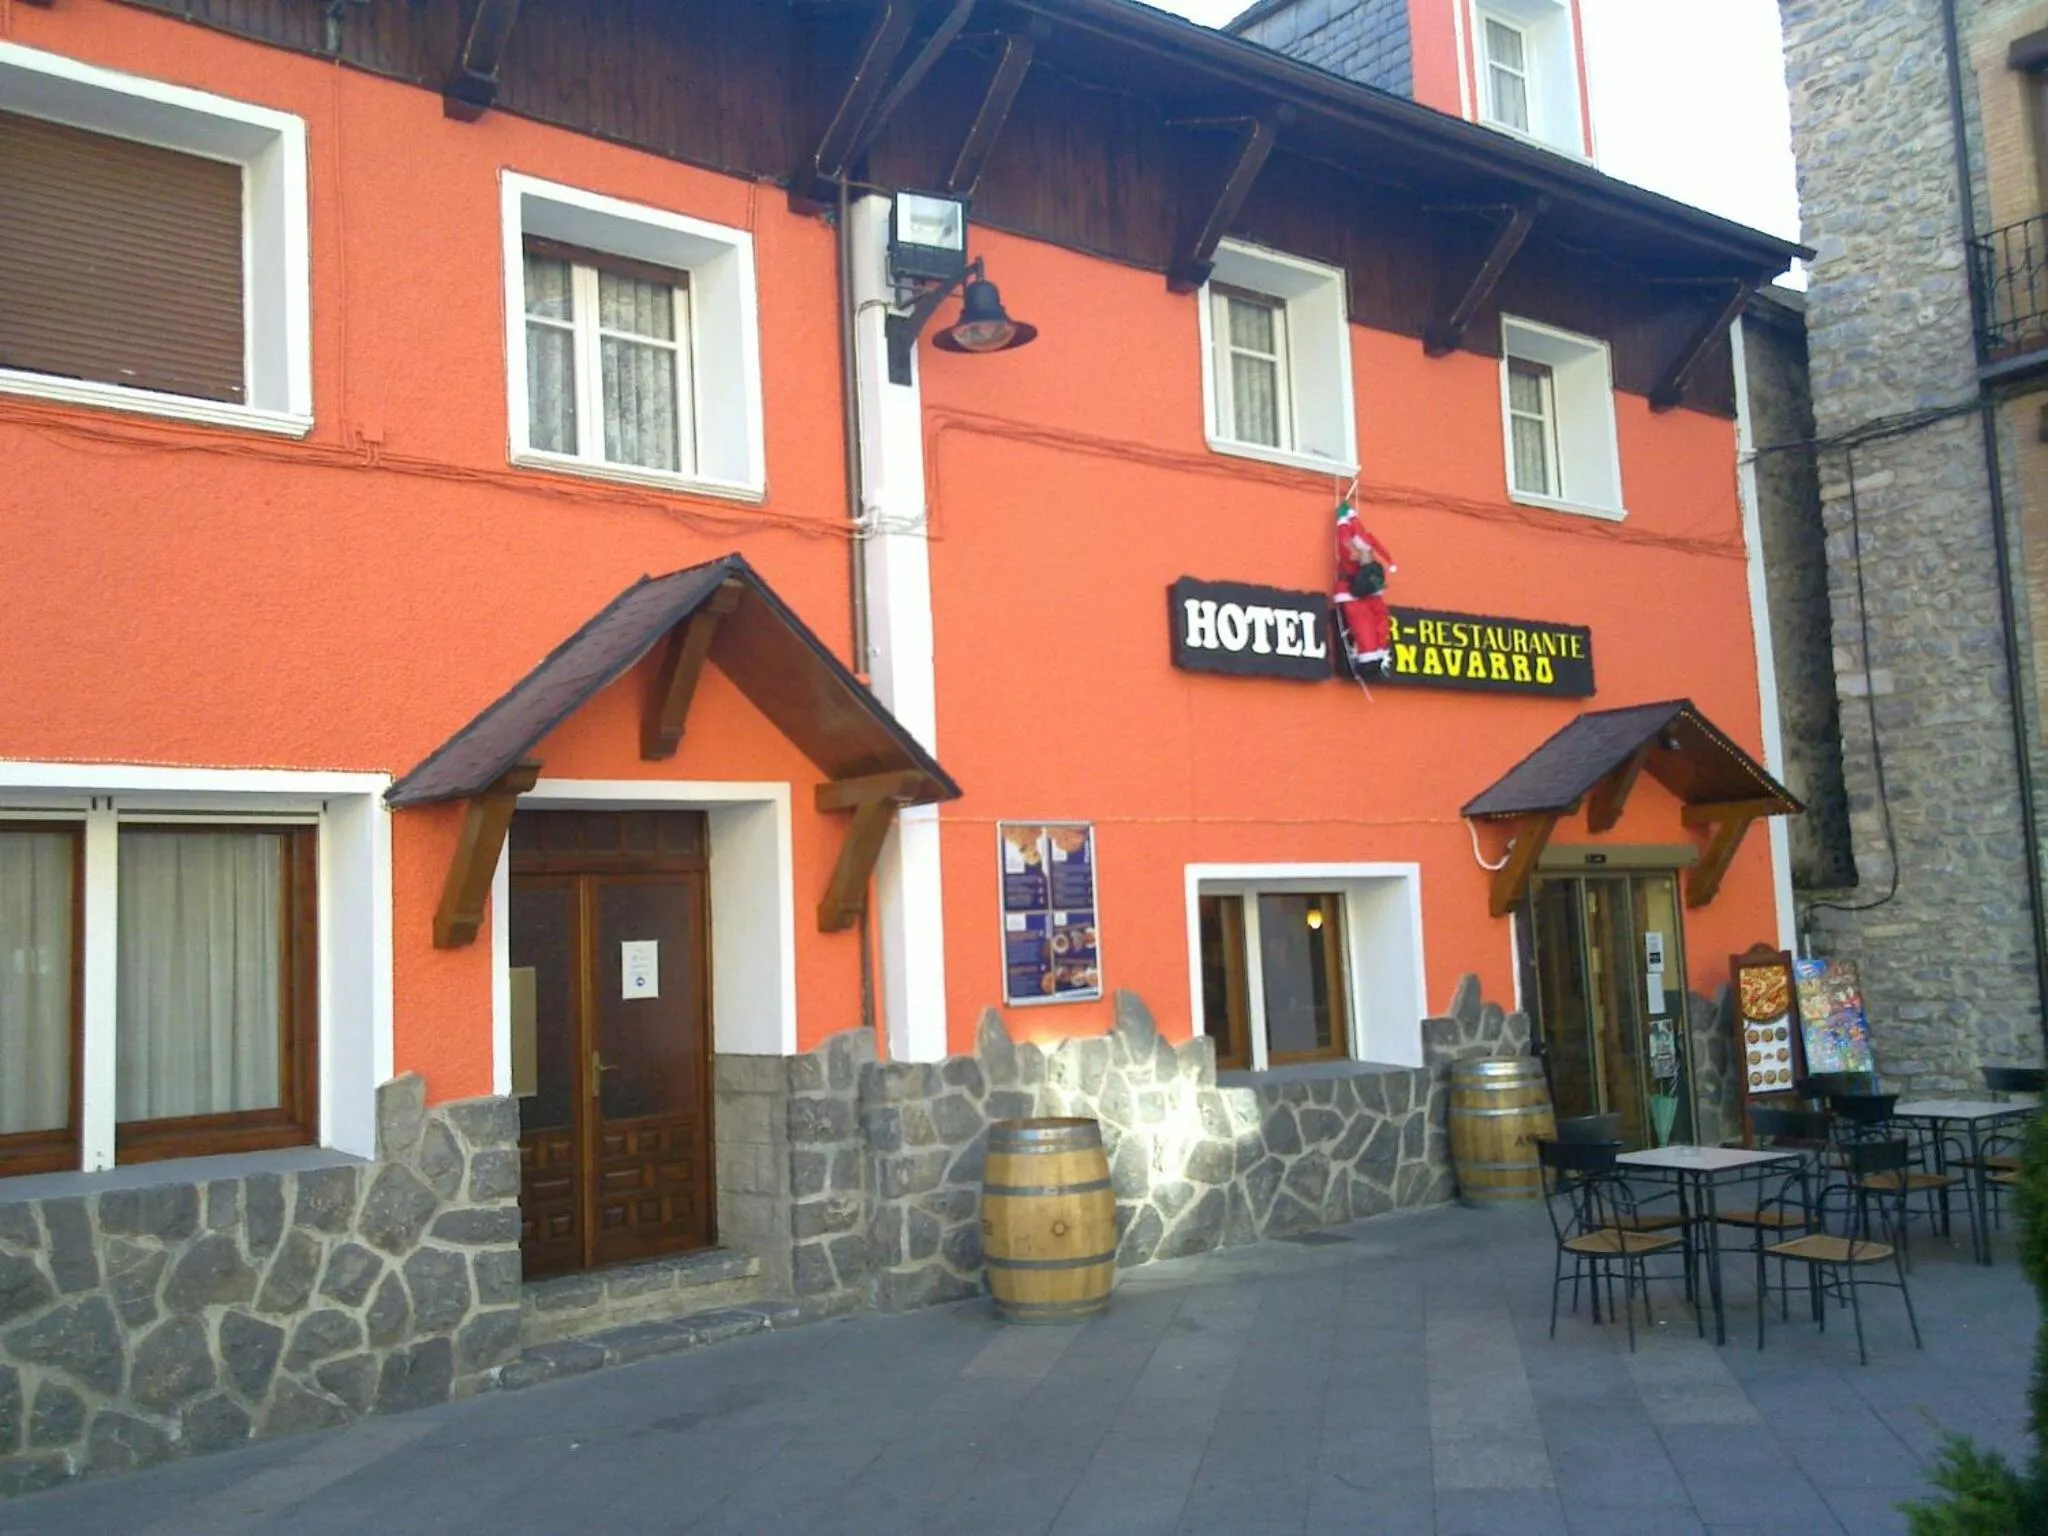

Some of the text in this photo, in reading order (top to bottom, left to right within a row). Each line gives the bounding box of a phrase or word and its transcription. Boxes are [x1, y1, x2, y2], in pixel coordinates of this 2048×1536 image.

[1184, 598, 1326, 659] HOTEL
[1387, 615, 1585, 659] R-RESTAURANTE
[1395, 643, 1554, 684] NAVARRO
